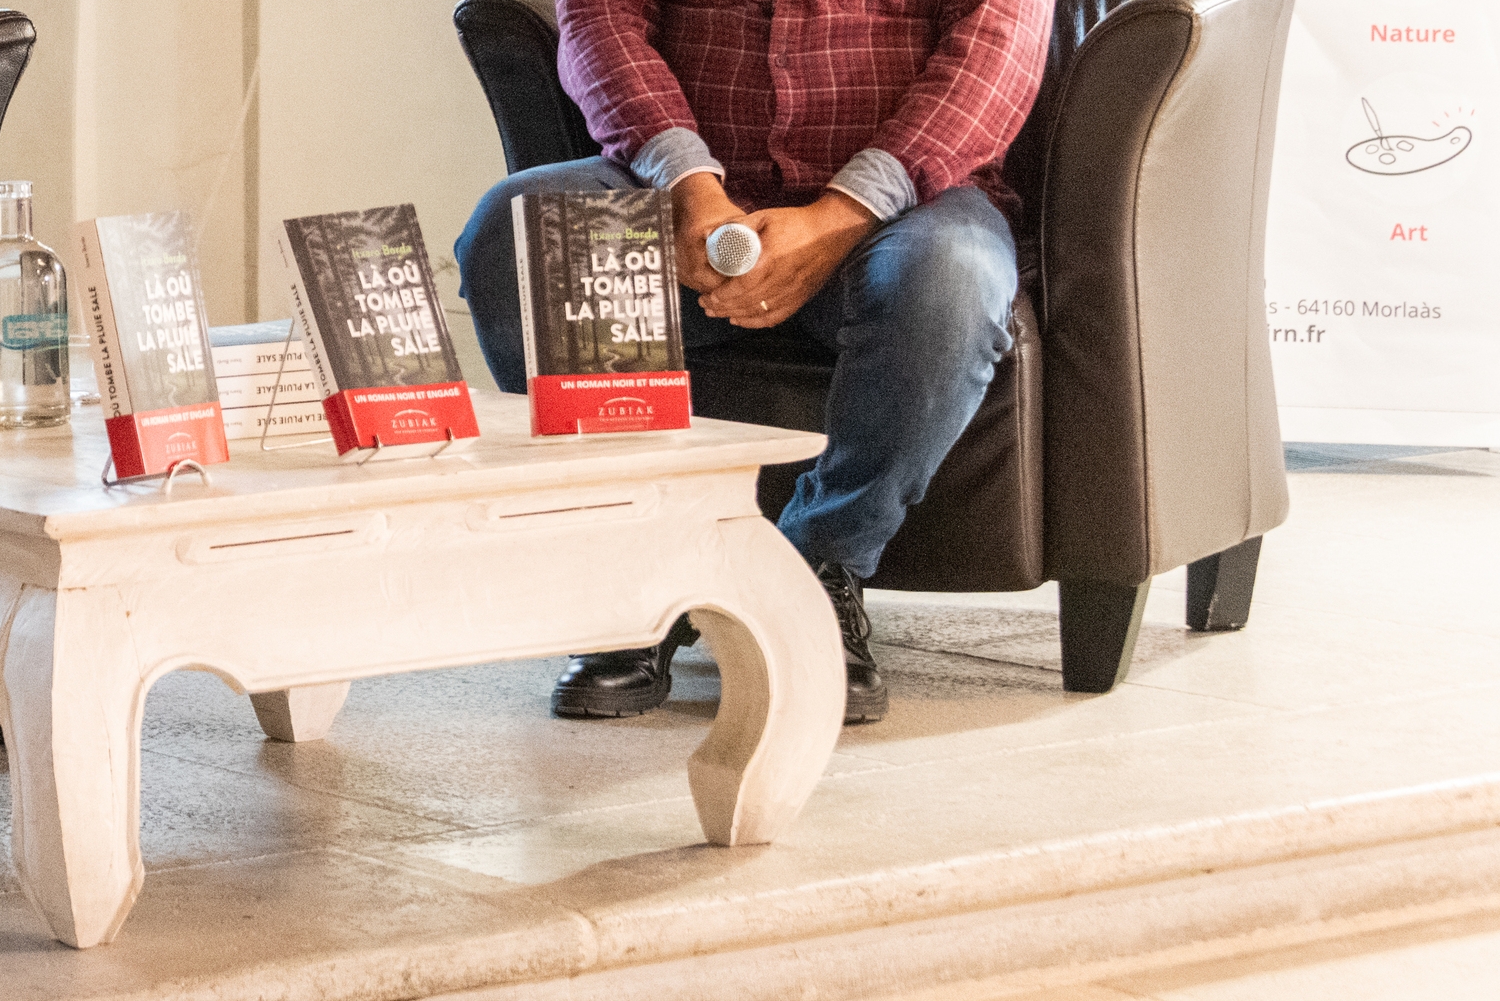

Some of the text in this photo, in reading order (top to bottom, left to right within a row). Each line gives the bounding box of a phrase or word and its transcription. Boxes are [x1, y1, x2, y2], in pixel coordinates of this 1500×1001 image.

[1370, 23, 1455, 43] Nature
[625, 227, 659, 240] Borda
[1390, 222, 1429, 242] Art
[591, 246, 662, 273] LÀ OÙ
[145, 270, 193, 299] LÀ OÙ
[358, 259, 422, 289] LÀ OÙ
[580, 274, 663, 296] TOMBE
[88, 286, 101, 313] SALE
[290, 283, 301, 308] SALE
[354, 287, 427, 313] TOMBE
[142, 300, 196, 325] TOMBE
[564, 298, 665, 321] LA PLUIE
[1297, 299, 1355, 316] 64160
[1362, 301, 1442, 319] Morlaàs
[94, 314, 106, 344] PLUIE
[299, 309, 311, 336] PLUIE
[346, 309, 434, 338] LA PLUIE
[610, 322, 667, 343] SALE
[137, 325, 200, 351] LA PLUIE
[309, 339, 316, 351] LA
[390, 333, 442, 357] SALE
[102, 347, 109, 360] LA
[167, 349, 205, 373] SALE
[256, 352, 302, 364] PLUE SALE
[313, 353, 328, 387] TOMBE
[103, 363, 118, 400] TOMBE
[278, 383, 302, 393] PLUIE
[304, 382, 315, 390] LA
[560, 376, 687, 389] UN ROMAN NOIR ET ENGAGÉ
[354, 395, 367, 403] UN
[367, 393, 396, 403] ROMAN
[396, 392, 416, 401] NOIR
[416, 390, 425, 400] ET
[279, 416, 303, 425] PLUIE
[304, 414, 315, 422] LA
[598, 406, 654, 416] ZUBIAK
[391, 417, 437, 429] ZUBIAK
